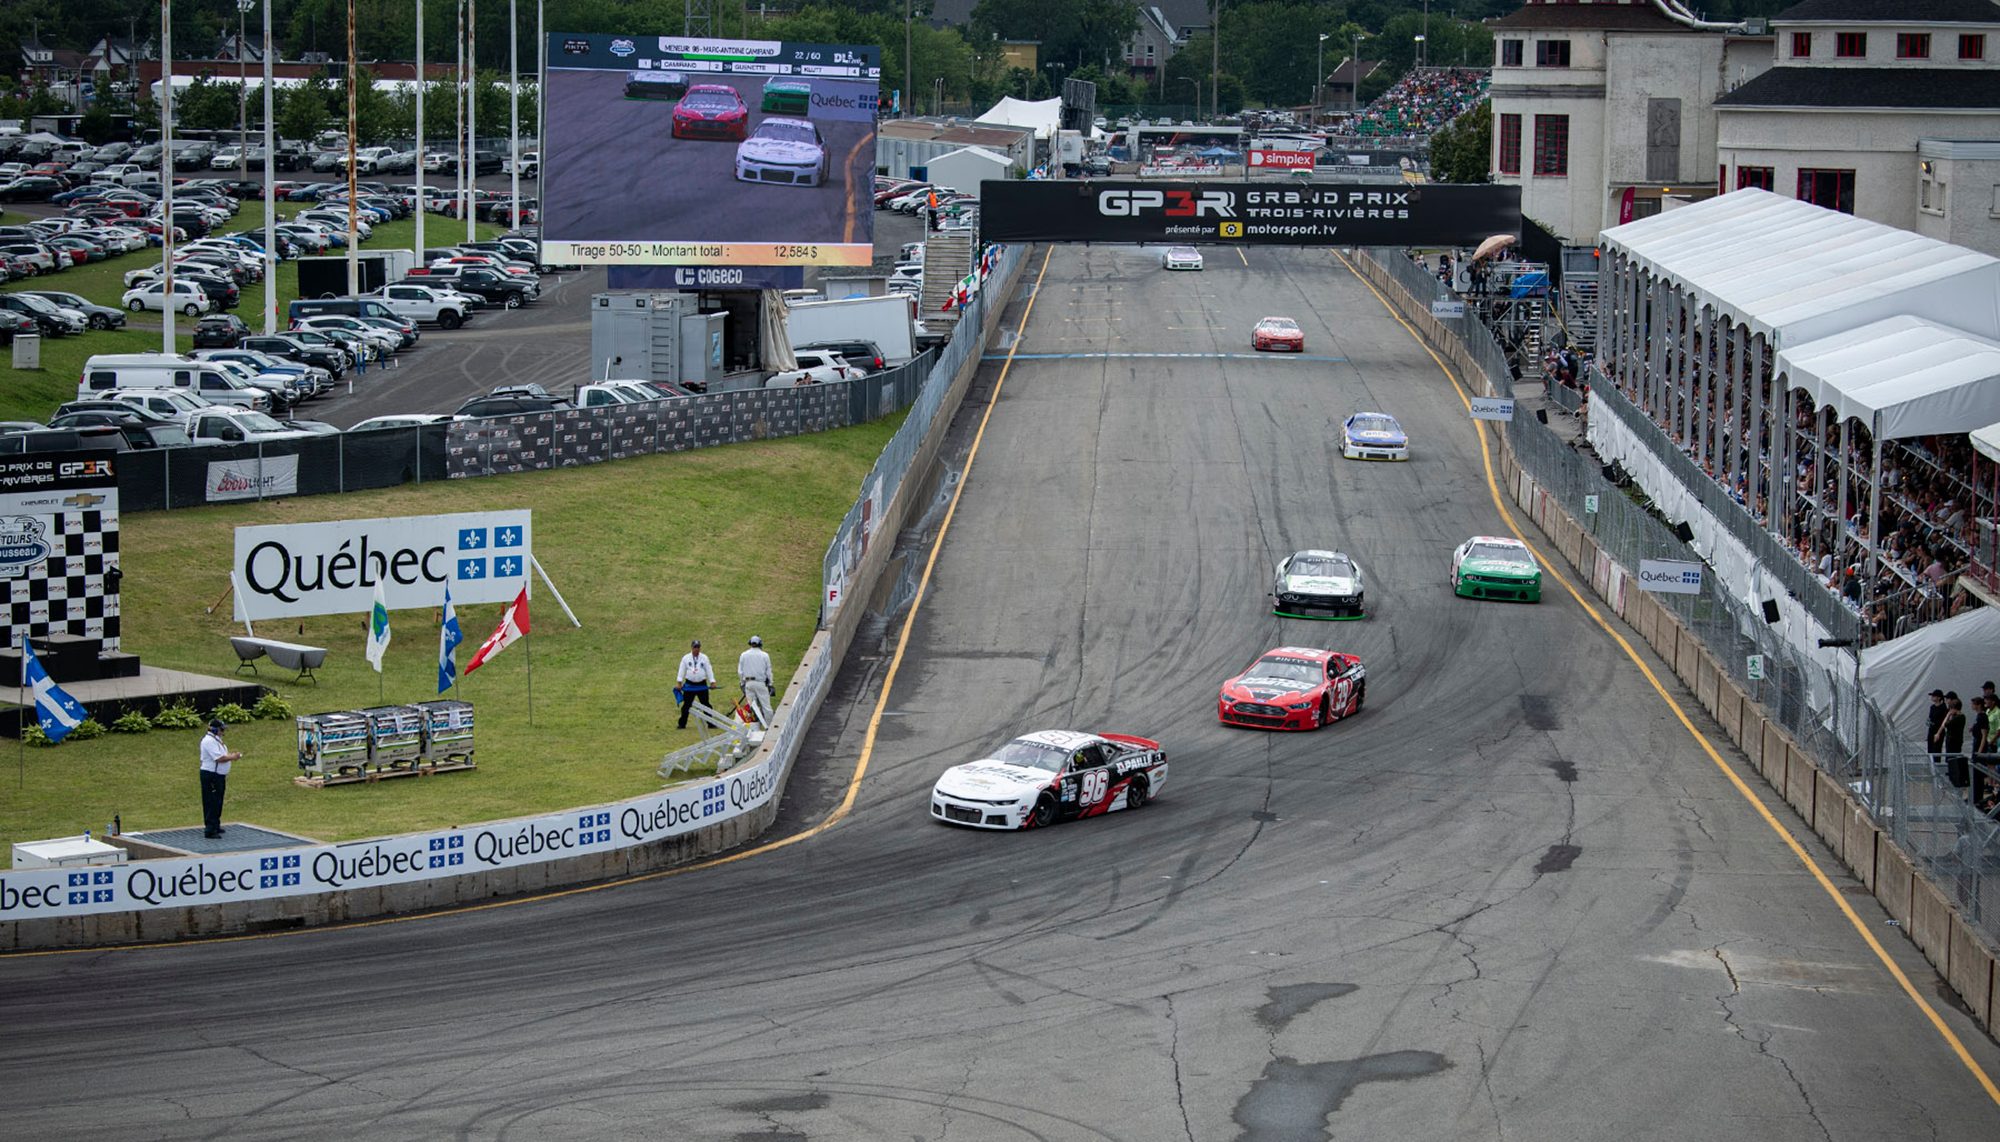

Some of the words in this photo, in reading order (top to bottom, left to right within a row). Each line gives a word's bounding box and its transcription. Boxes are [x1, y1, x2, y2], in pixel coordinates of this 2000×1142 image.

[703, 45, 744, 54] MARC-ANTOINE
[745, 46, 774, 55] CAMIRAND
[794, 51, 804, 59] 22
[810, 51, 821, 60] 60
[664, 61, 697, 69] CAMIRAND
[811, 92, 855, 108] Québec
[1266, 153, 1311, 166] simplex
[1099, 190, 1237, 217] GP3R
[1350, 192, 1409, 205] PRIX
[1246, 206, 1409, 218] TROIS-RIVIÈRES
[1165, 224, 1200, 234] présenté
[1202, 226, 1216, 235] par
[1247, 223, 1337, 236] motorsport.tv
[571, 243, 605, 260] Tirage
[609, 243, 642, 257] 50-50
[652, 244, 696, 257] Montant
[700, 244, 723, 257] total
[774, 244, 809, 260] 12,584
[698, 268, 743, 284] COGECO
[1471, 404, 1499, 414] Québec
[8, 462, 34, 473] PRIX
[36, 461, 53, 470] DE
[60, 460, 114, 476] GP3R
[217, 474, 248, 492] Coors
[21, 498, 59, 506] CHEVROLET
[1, 534, 32, 545] TOURS
[0, 547, 37, 557] usseau
[245, 534, 449, 604] Québec
[1640, 566, 1681, 584] Québec
[829, 590, 838, 601] F
[730, 769, 769, 808] Québec
[1079, 768, 1110, 807] 96
[620, 799, 700, 841] Québec
[474, 823, 575, 866] Québec
[312, 843, 424, 887] Québec
[127, 864, 254, 905] Québec
